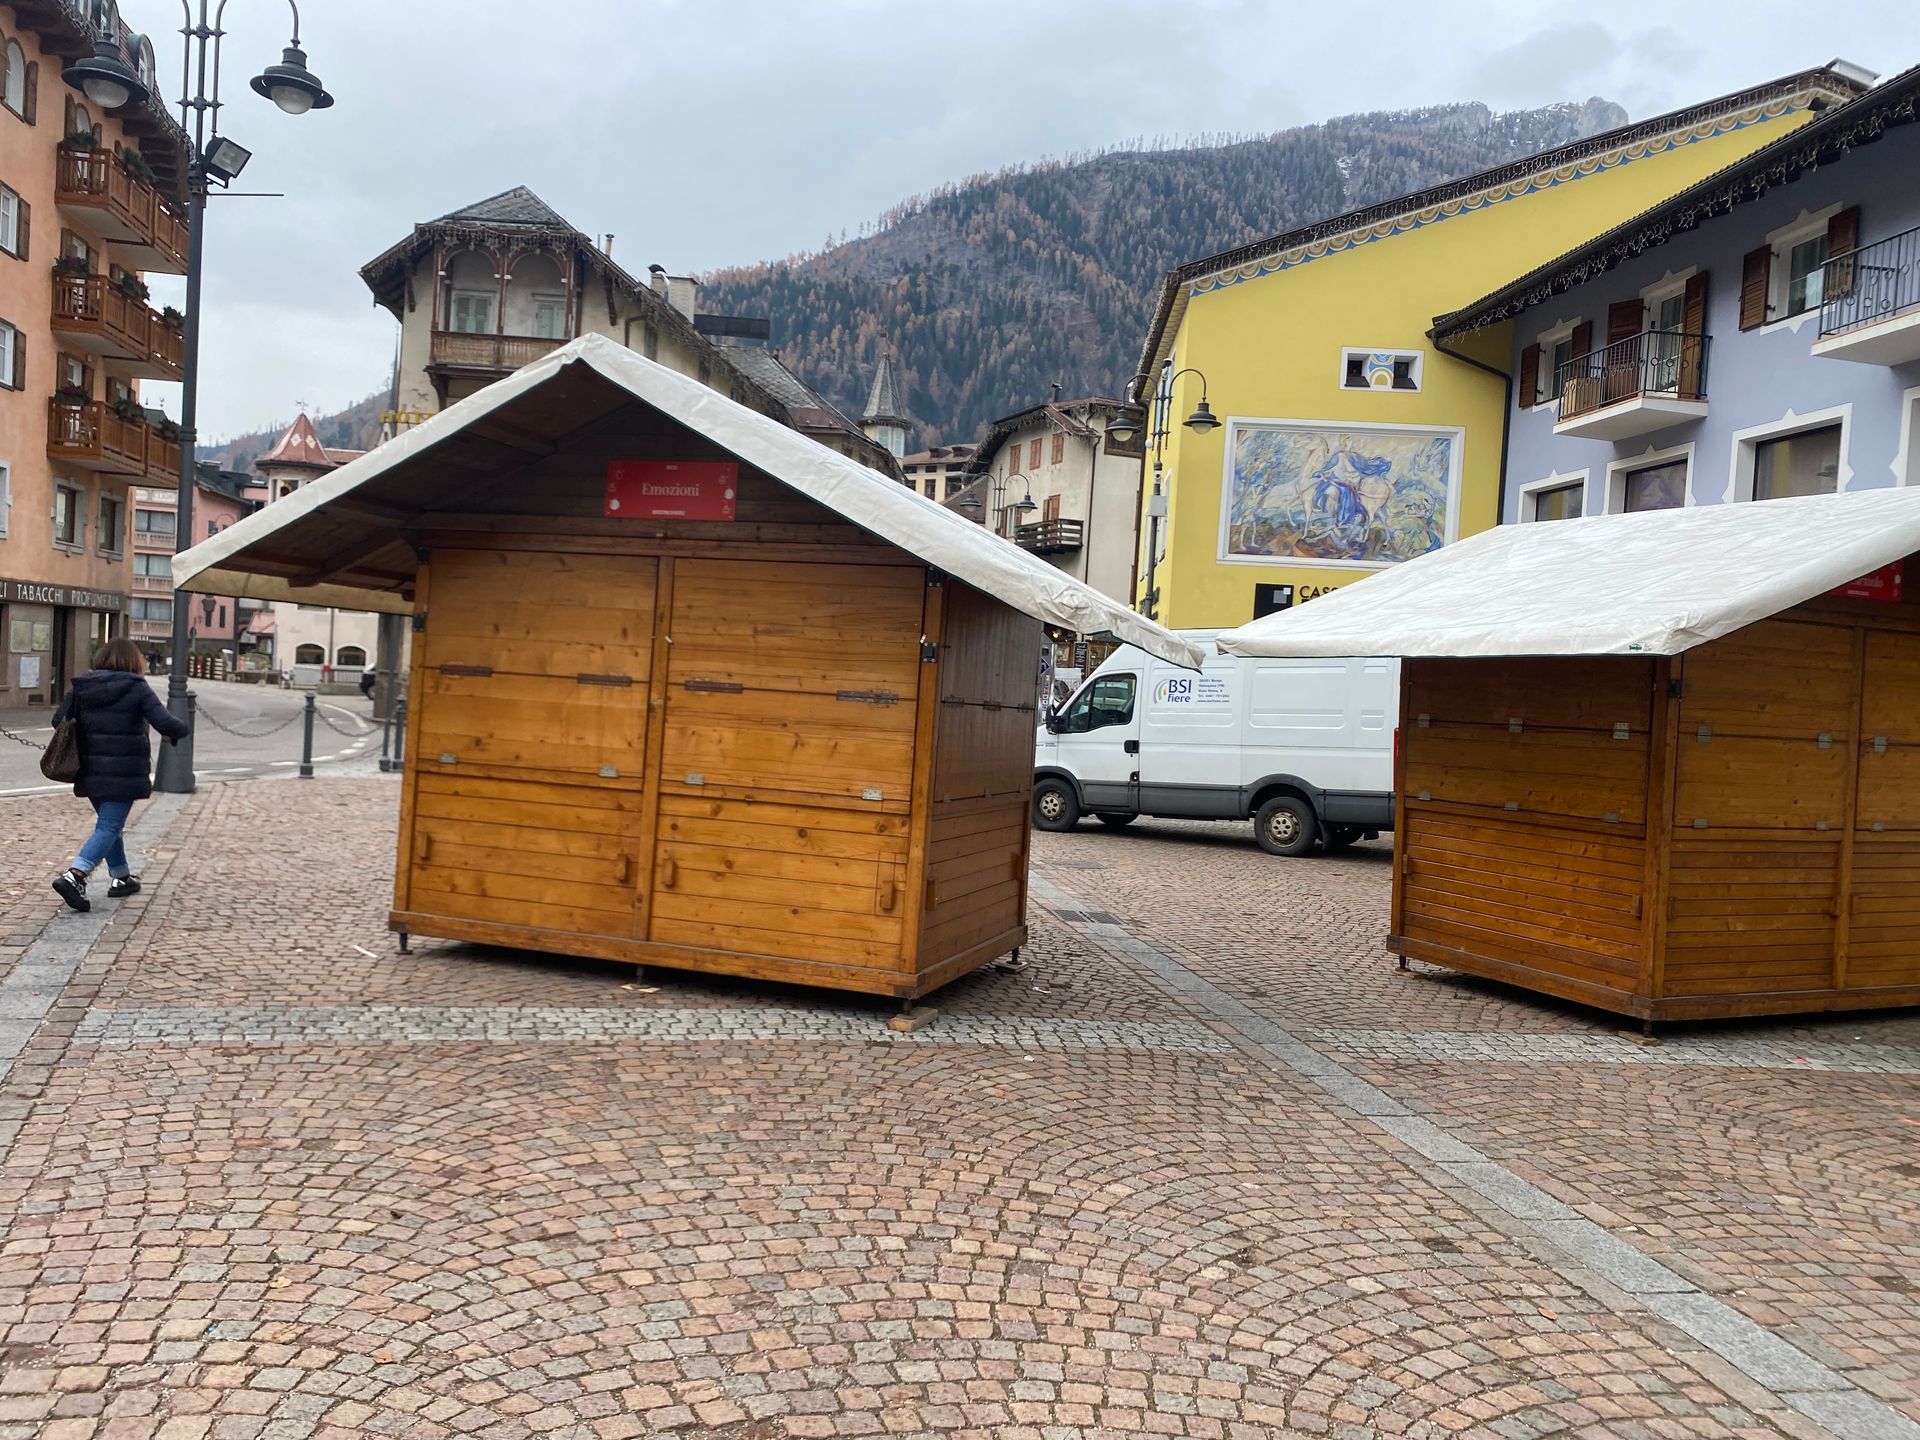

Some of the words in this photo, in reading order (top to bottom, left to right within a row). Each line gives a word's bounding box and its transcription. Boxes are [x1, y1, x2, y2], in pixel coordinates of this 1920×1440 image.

[642, 483, 700, 497] Emozioni
[17, 584, 64, 603] TABACCHI
[1168, 679, 1192, 694] BSI
[1167, 693, 1191, 703] fiere
